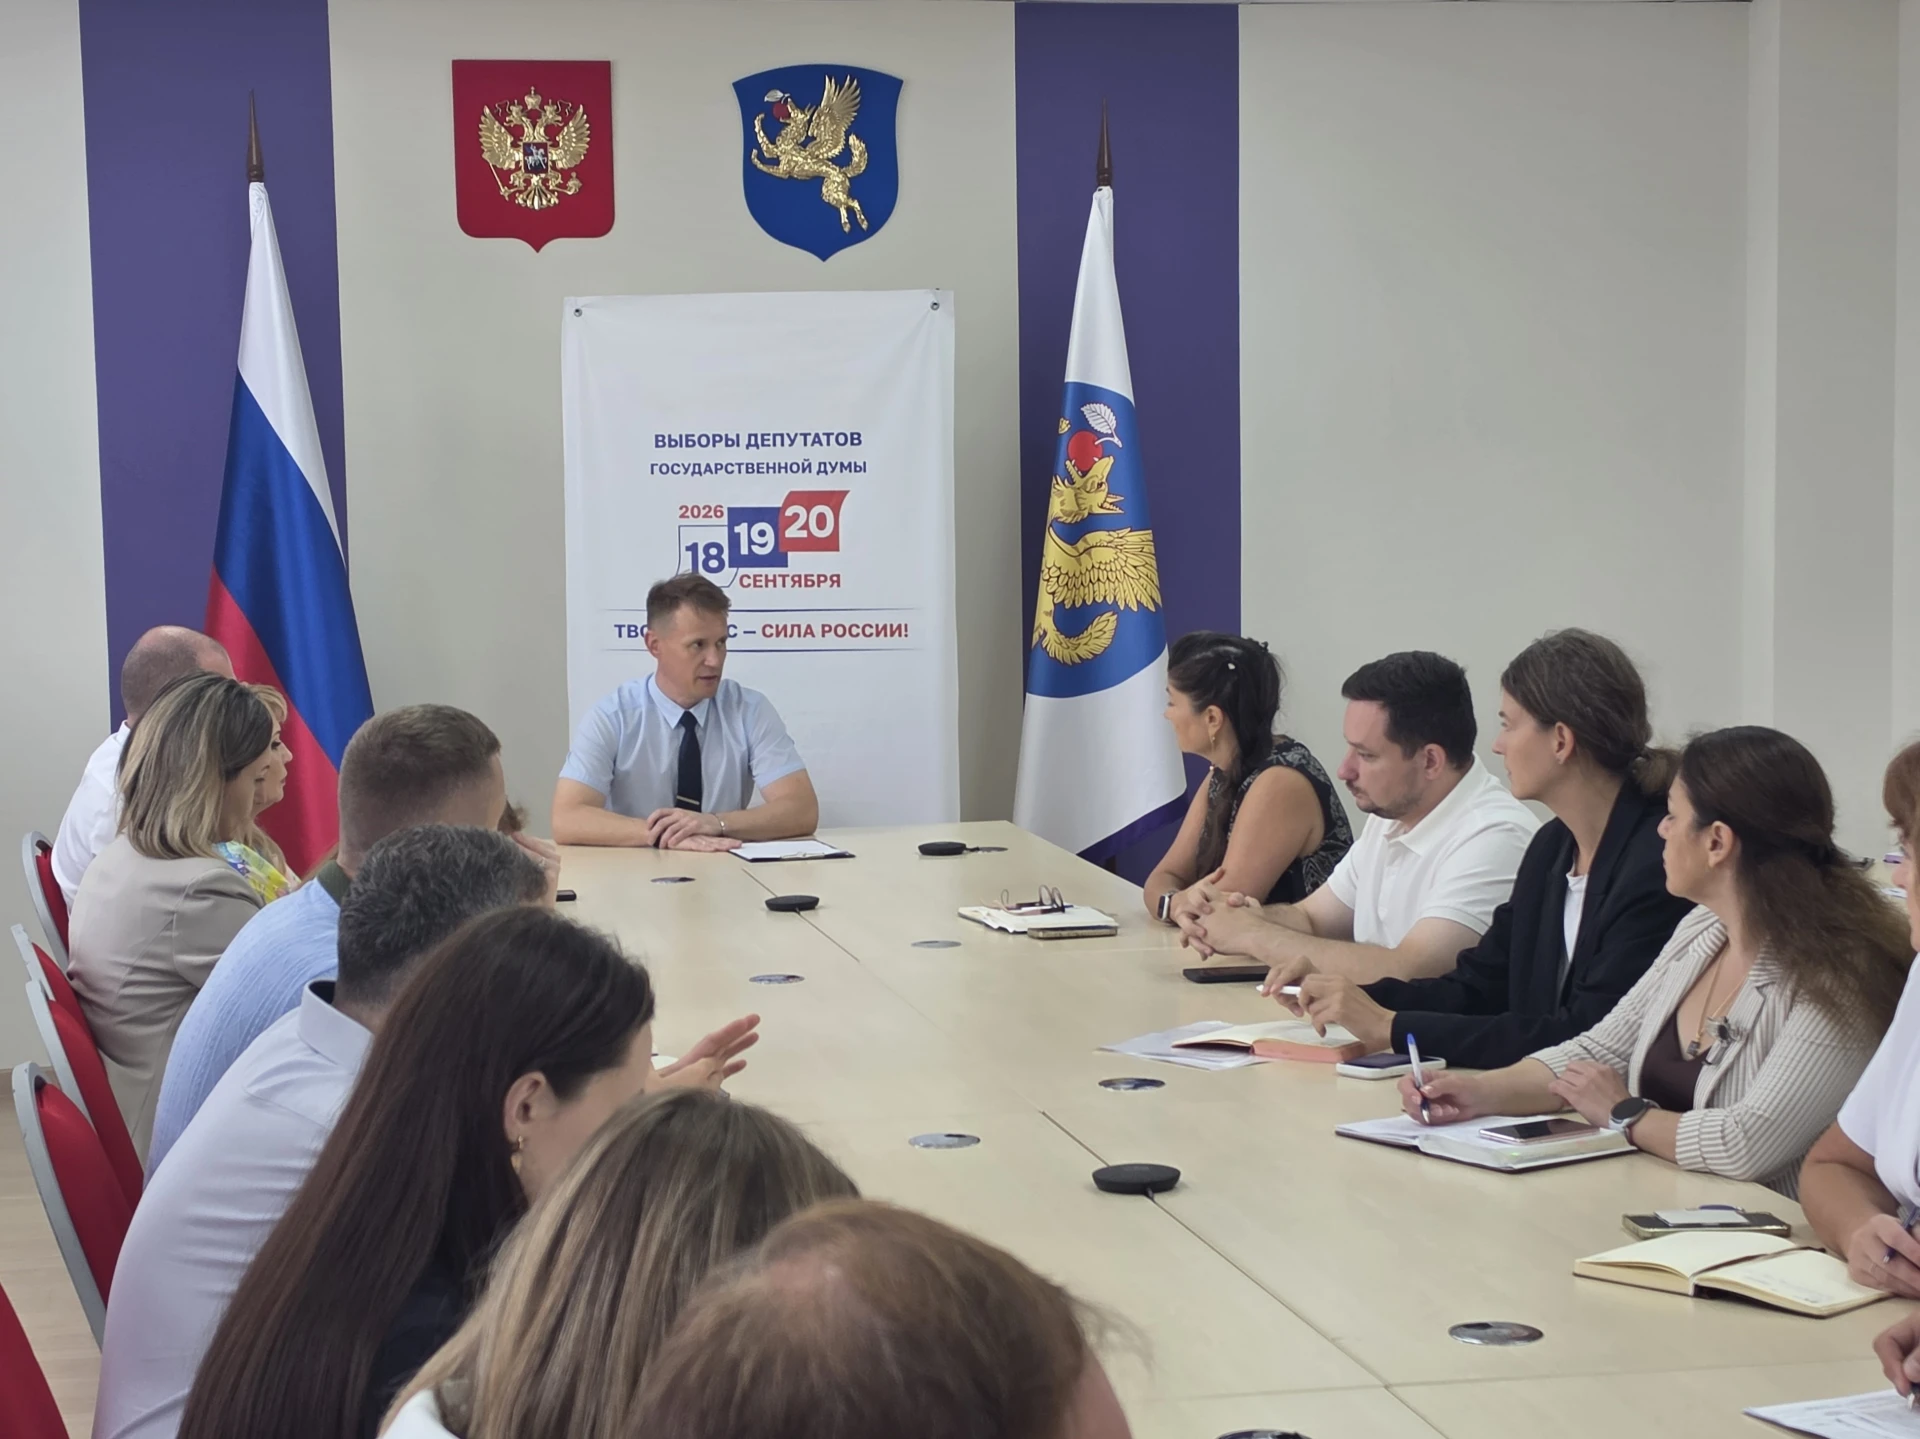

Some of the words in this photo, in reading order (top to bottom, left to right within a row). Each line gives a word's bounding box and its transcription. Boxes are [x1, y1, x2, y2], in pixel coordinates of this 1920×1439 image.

[654, 433, 741, 448] ВЫБОРЫ
[745, 432, 863, 450] ДЕПУТАТОВ
[650, 458, 813, 476] ГОСУДАРСТВЕННОЙ
[816, 461, 867, 476] ДУМЫ
[678, 504, 724, 519] 2026
[685, 541, 726, 574] 18
[733, 521, 775, 555] 19
[784, 504, 835, 538] 20
[739, 573, 841, 588] СЕНТЯБРЯ
[761, 623, 816, 638] СИЛА
[821, 623, 909, 638] РОССИИ!
